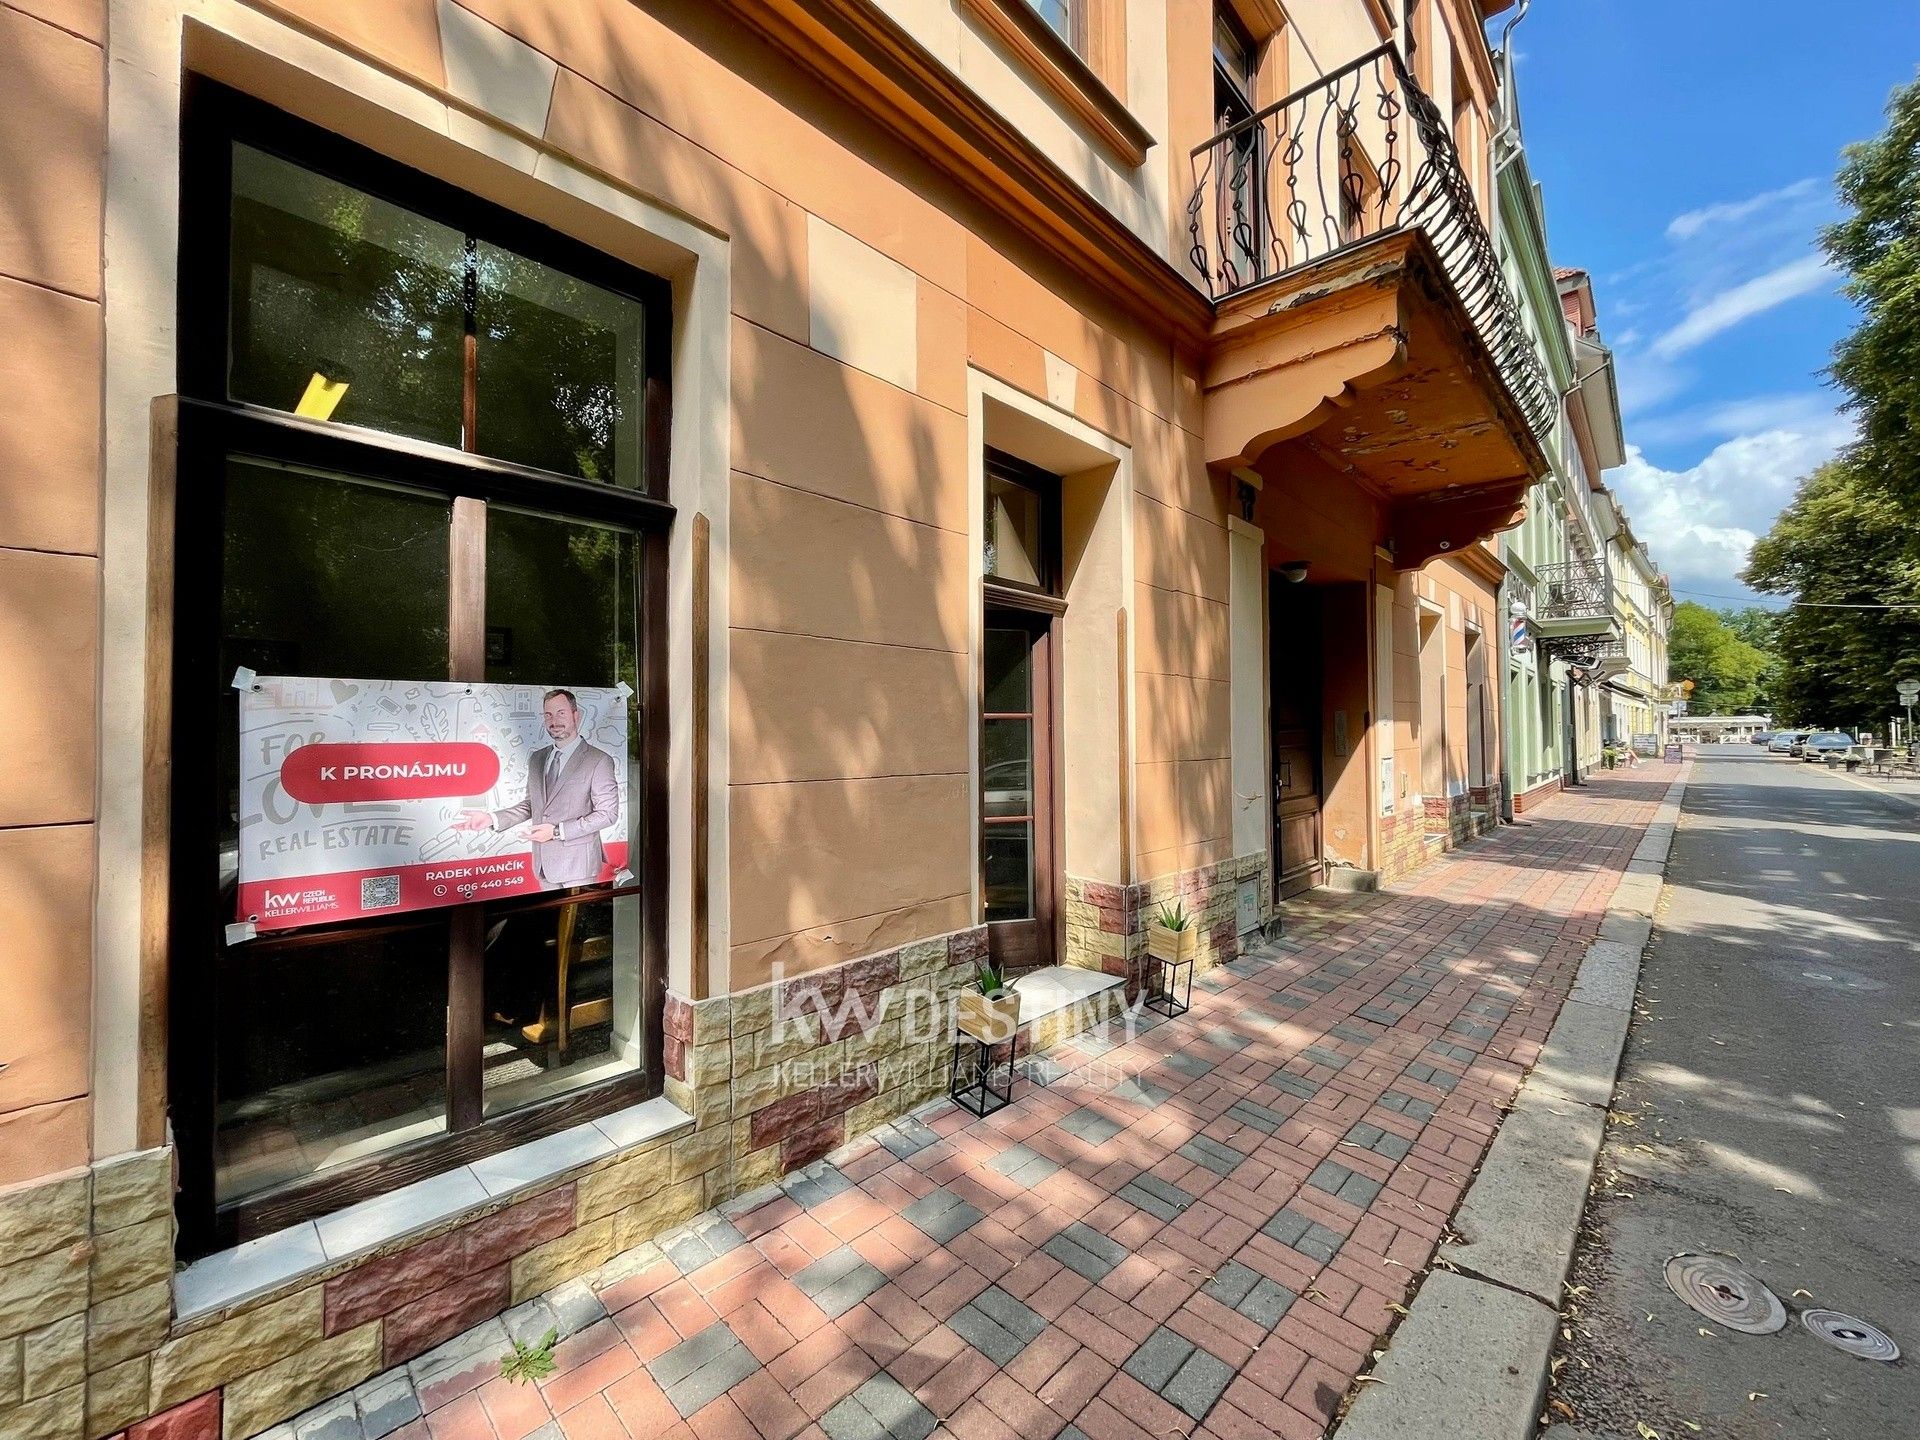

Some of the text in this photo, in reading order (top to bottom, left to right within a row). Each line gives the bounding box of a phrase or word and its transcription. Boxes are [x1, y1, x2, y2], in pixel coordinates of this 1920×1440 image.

[320, 762, 467, 781] K PRONÁJMU
[259, 825, 414, 861] REAL ESTATE
[425, 860, 525, 881] RADEK IVANČÍK
[302, 889, 326, 898] CZECH
[456, 876, 524, 893] 606 440 549
[265, 890, 301, 909] kw
[302, 894, 336, 904] REPUBLIC
